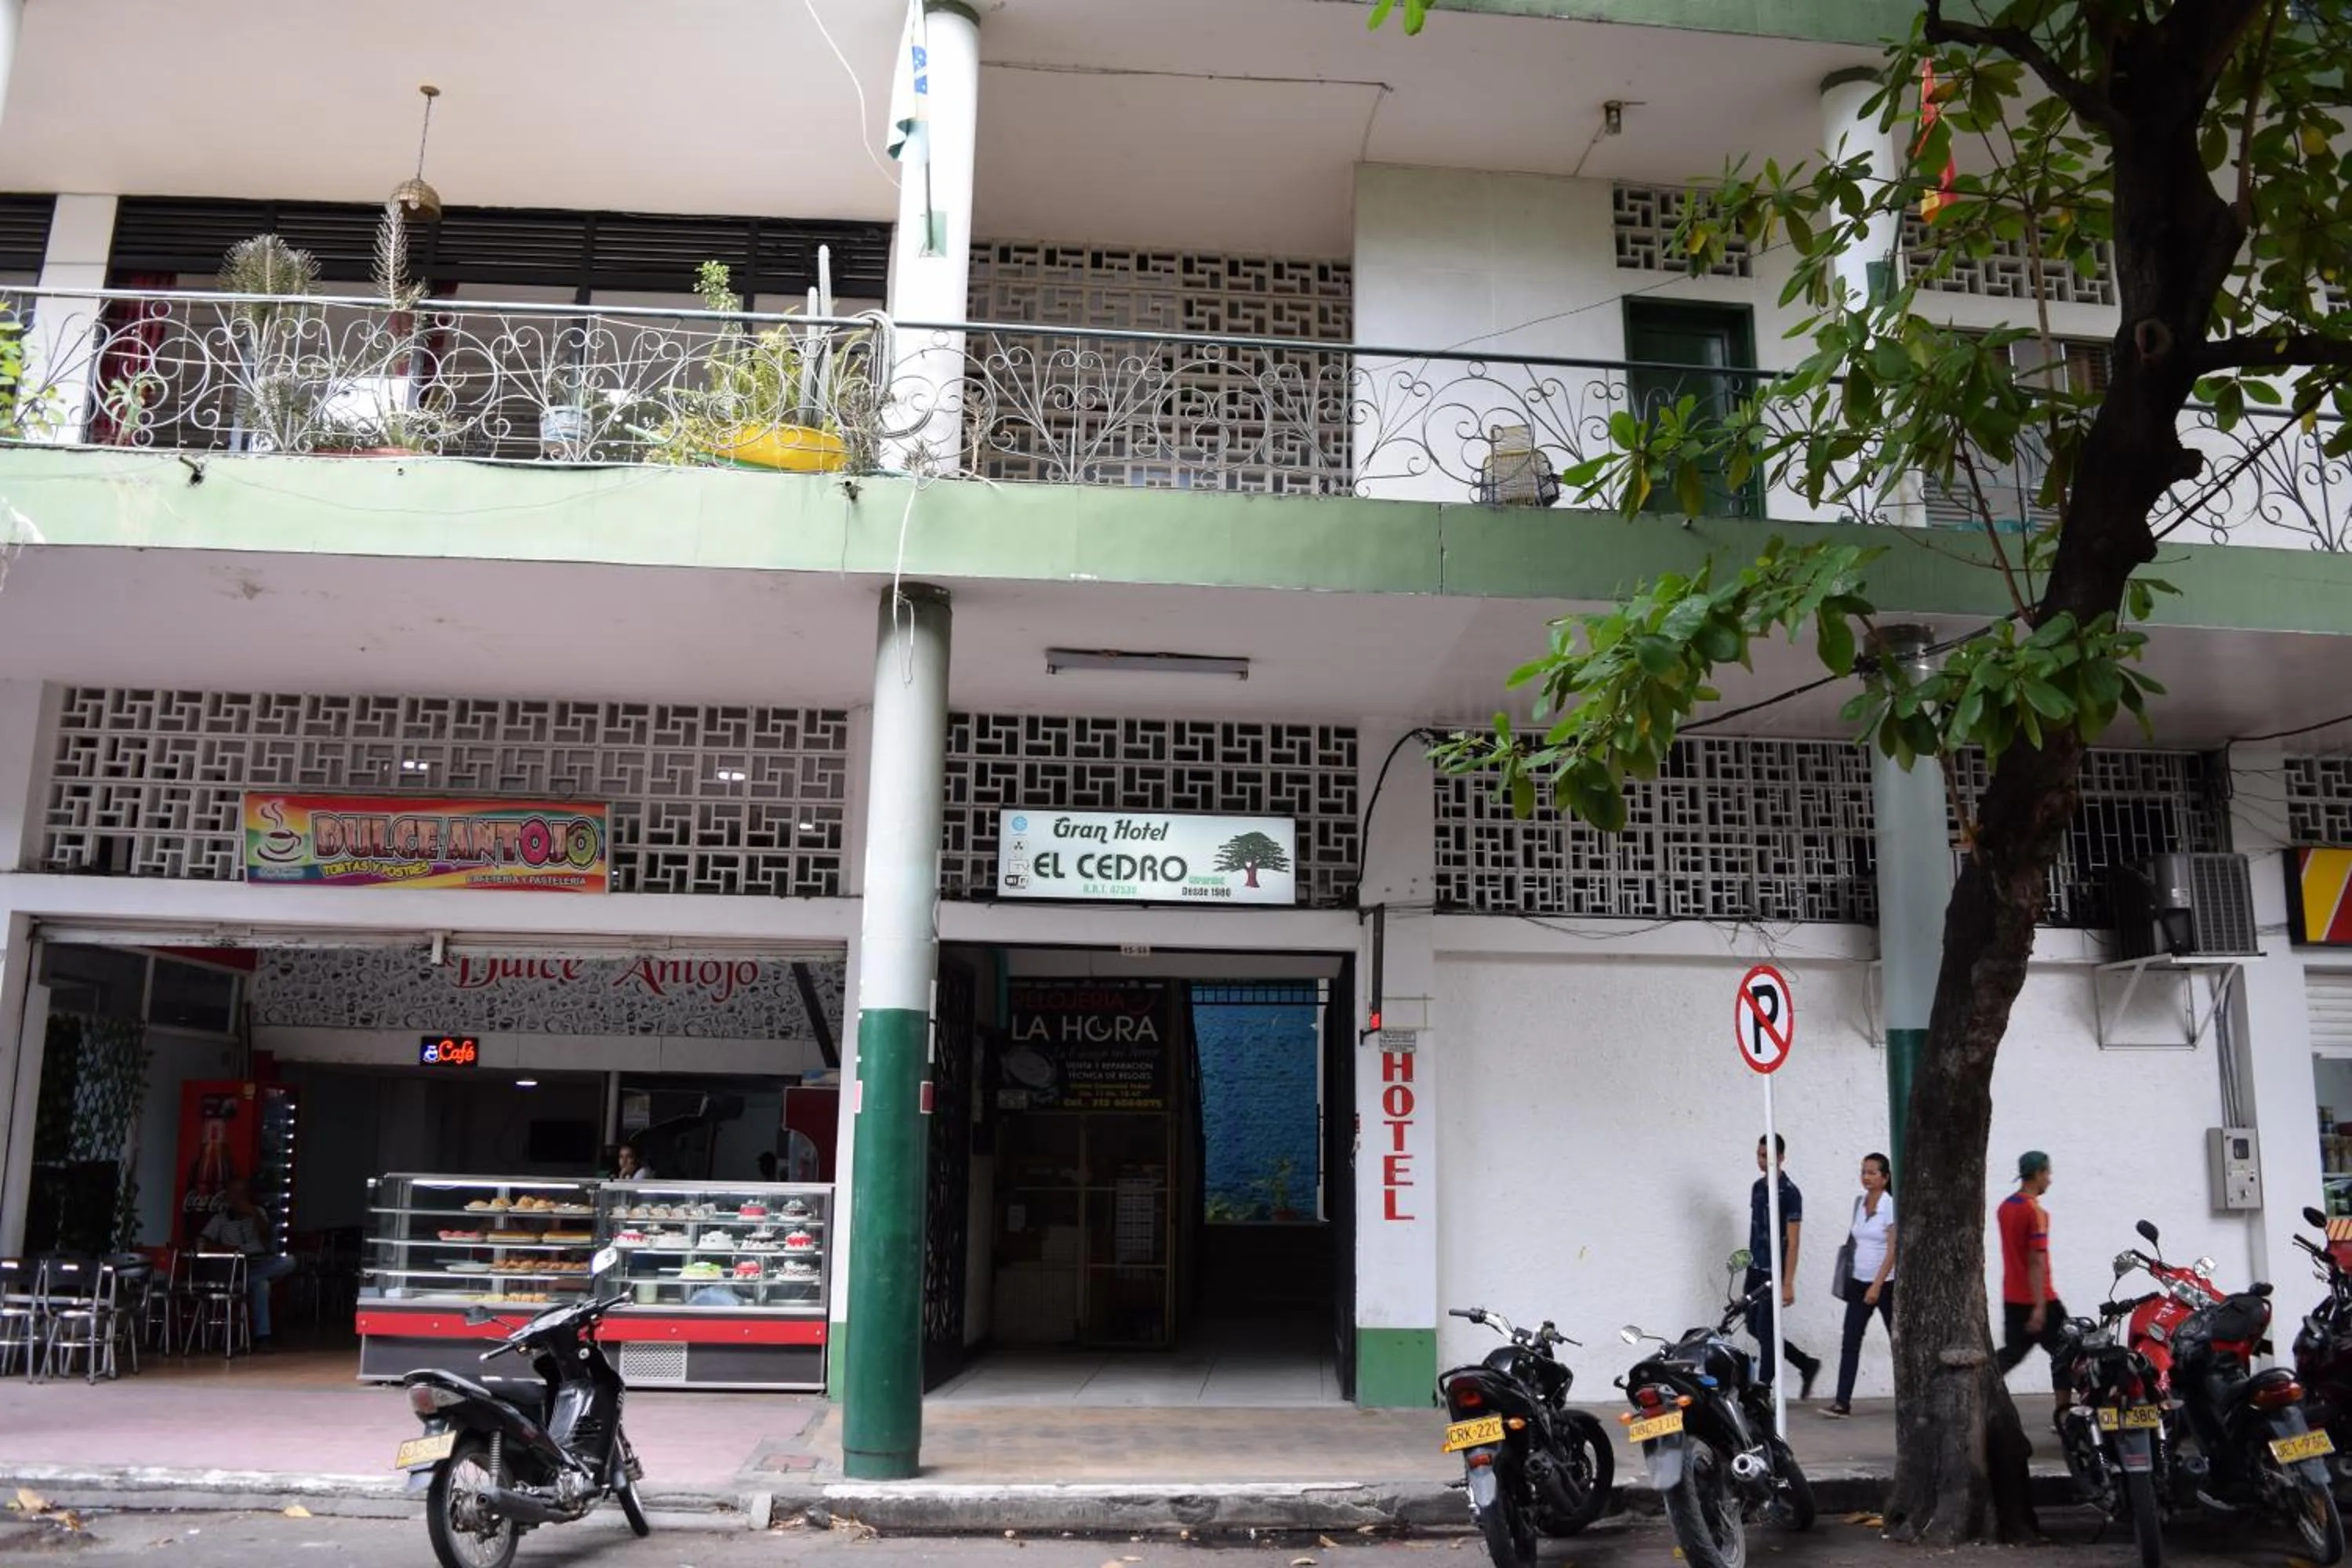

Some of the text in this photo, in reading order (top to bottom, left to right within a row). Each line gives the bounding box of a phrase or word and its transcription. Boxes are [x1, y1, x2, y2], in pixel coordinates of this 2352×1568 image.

[313, 813, 600, 869] DULCE ANTOJO
[1053, 817, 1169, 844] Gran Hotel
[1033, 852, 1187, 882] EL CEDRO
[1181, 887, 1209, 897] Desde
[1011, 1015, 1160, 1042] LA HORA
[439, 1040, 474, 1065] Café
[1382, 1052, 1415, 1221] HOTEL
